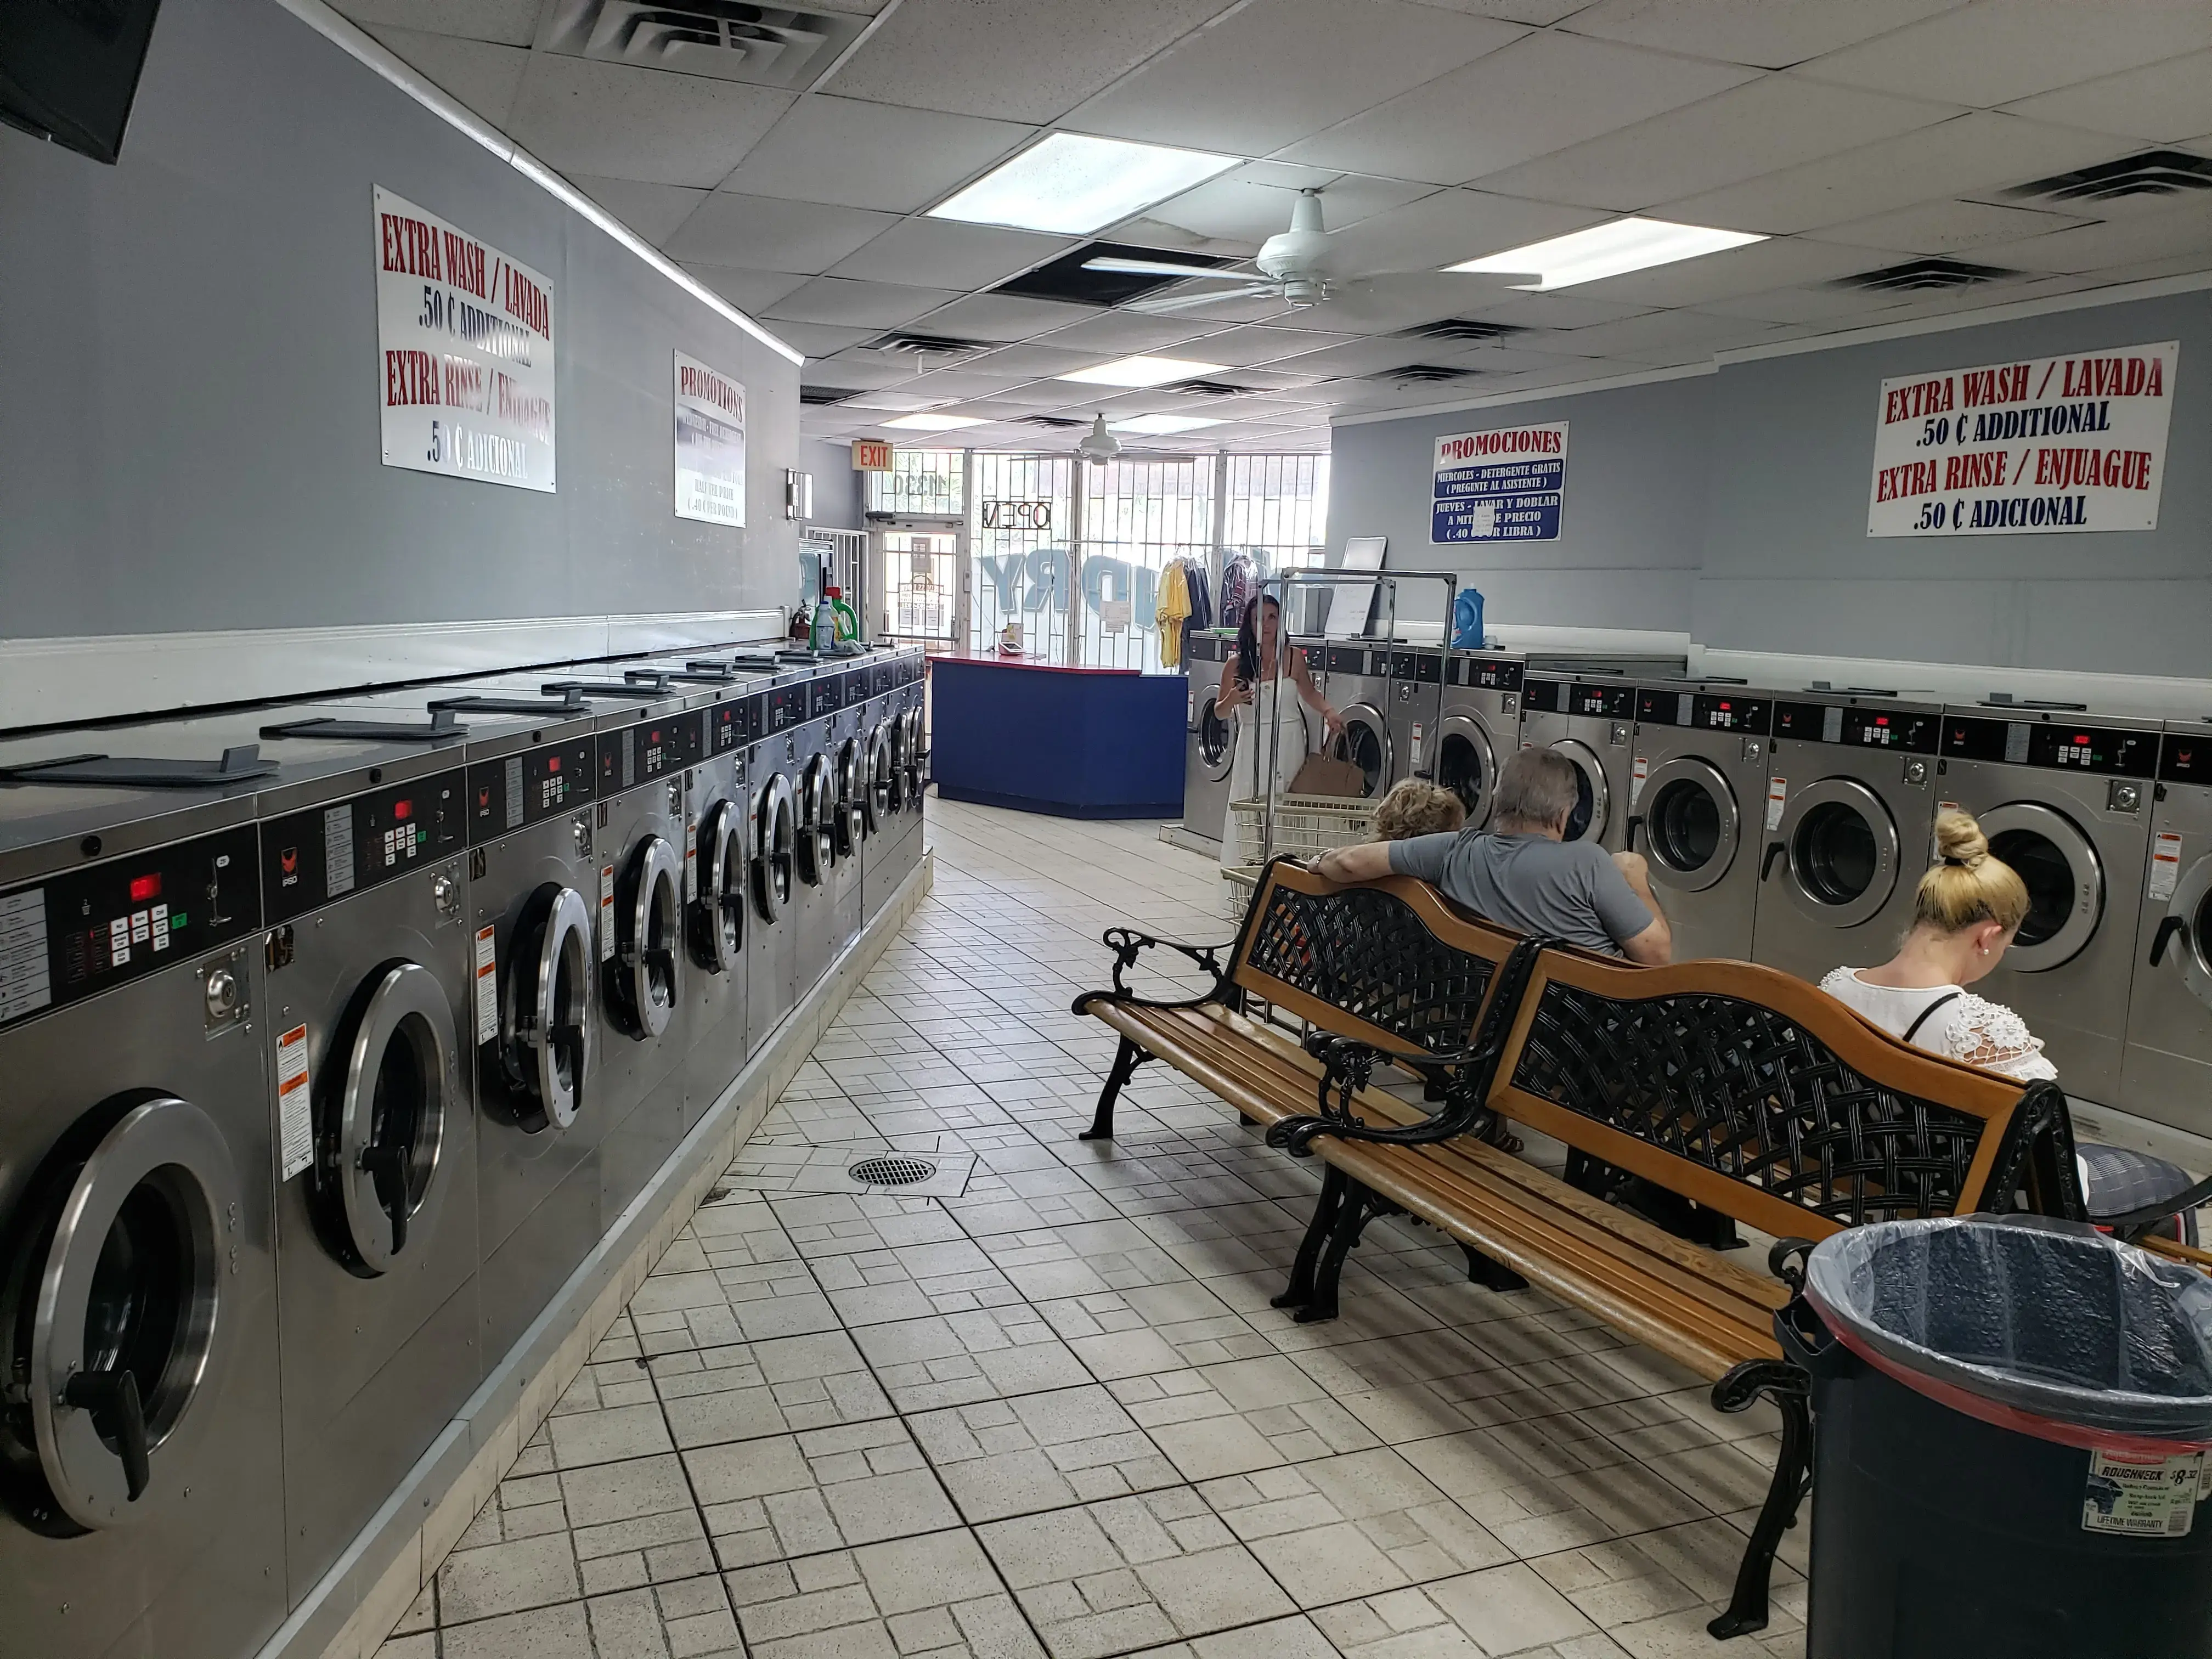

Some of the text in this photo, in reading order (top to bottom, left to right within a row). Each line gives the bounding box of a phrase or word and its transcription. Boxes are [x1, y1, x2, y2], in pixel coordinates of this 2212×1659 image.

[381, 213, 549, 341] EXTRA WASH / LAVADA
[419, 285, 443, 332] .50
[460, 301, 532, 368] ADDITIONAL
[386, 351, 440, 407] EXTRA
[444, 354, 482, 413] RINSE
[487, 368, 494, 416] /
[681, 366, 742, 423] PROMOTIONS
[1885, 358, 2163, 425] EXTRA WASH / LAVADA
[1916, 417, 1949, 447] .50
[1973, 401, 2110, 442] ADDITIONAL
[427, 420, 452, 463] .50
[467, 430, 528, 479] ADICIONAL
[861, 445, 888, 467] EXIT
[1440, 431, 1561, 464] PROMOCIONES
[1437, 470, 1474, 483] MIERCOLES
[1481, 465, 1530, 479] DETERGENTE
[1532, 462, 1560, 474] GRATIS
[1490, 481, 1500, 490] AL
[1876, 449, 2151, 503] EXTRA RINSE / ENJUAGUE
[695, 479, 733, 500] HALF THE PRICE
[707, 501, 717, 515] PER
[718, 503, 735, 518] POUND
[1436, 502, 1465, 514] JUEVES
[1507, 499, 1513, 509] Y
[1516, 496, 1558, 508] DOBLAR
[1448, 516, 1453, 526] A
[1504, 511, 1542, 523] PRECIO
[1914, 502, 1945, 529] .50
[1969, 496, 2087, 528] ADICIONAL
[1503, 526, 1534, 537] LIBRA
[2102, 1466, 2164, 1481] ROUGHNECK
[2126, 1519, 2163, 1528] WARRANTY
